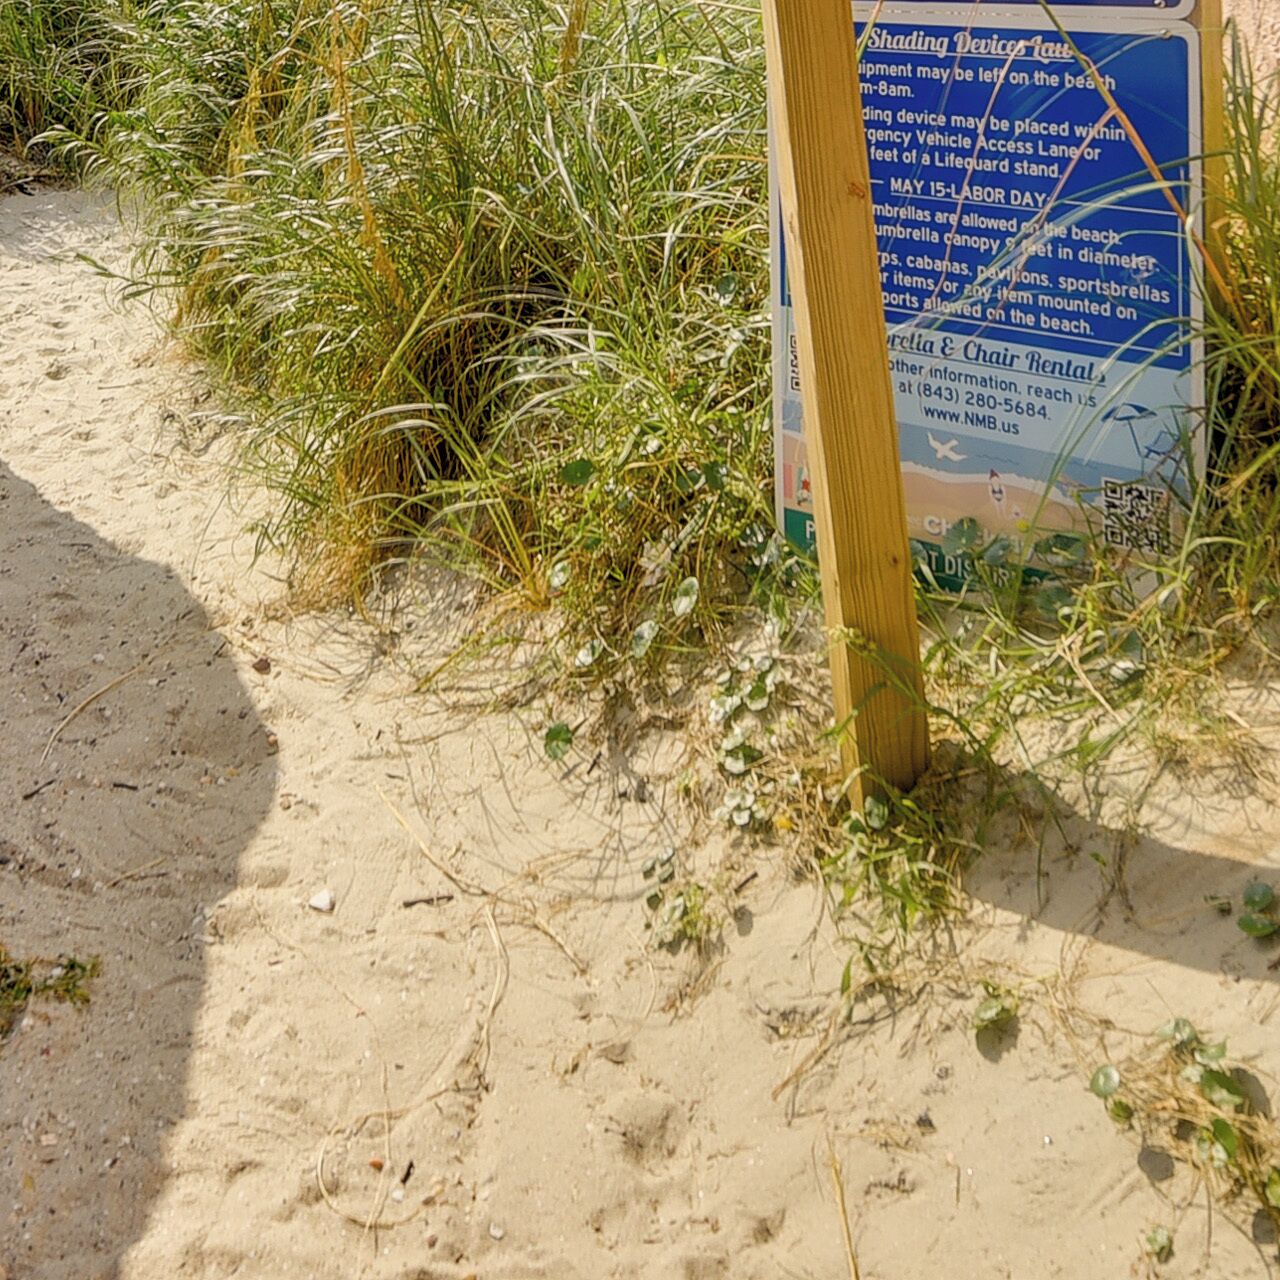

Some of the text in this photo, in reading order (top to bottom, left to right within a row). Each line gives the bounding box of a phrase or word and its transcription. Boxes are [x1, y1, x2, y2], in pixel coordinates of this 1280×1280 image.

[867, 27, 1073, 64] Shading Devices Law
[859, 81, 915, 98] m-8am.
[916, 66, 950, 84] may
[954, 67, 974, 81] be
[978, 67, 1004, 83] left
[1009, 71, 1029, 85] on
[1033, 70, 1060, 86] the
[1064, 72, 1116, 90] beah
[862, 106, 1126, 141] ding device may be placed within
[870, 145, 1062, 179] feet of a Lifeguard stand.
[915, 129, 972, 149] Vehicle
[978, 136, 1034, 155] Access
[1038, 140, 1078, 159] Lane
[1084, 148, 1101, 161] or
[890, 177, 925, 195] MAY
[929, 181, 1006, 204] 15-LABOR
[872, 203, 932, 222] mbrellas
[934, 211, 958, 225] are
[961, 212, 1018, 232] allowed
[1043, 222, 1068, 237] the
[874, 223, 940, 244] umbrella
[943, 232, 1000, 255] canopy
[1023, 240, 1053, 258] eet
[1058, 243, 1074, 261] in
[1078, 247, 1160, 273] diameter.
[942, 280, 959, 294] or
[964, 284, 992, 303] any
[997, 285, 1033, 305] item
[1038, 293, 1111, 317] mounted
[1116, 306, 1138, 321] on
[977, 265, 1053, 288] pavilons,
[1058, 276, 1170, 304] sportsbrellas
[923, 296, 982, 319] allowed
[986, 307, 1005, 322] on
[1009, 308, 1035, 327] the
[1040, 312, 1095, 336] beach.
[886, 332, 935, 354] rella
[940, 336, 956, 357] &
[963, 339, 1020, 369] Chair
[888, 358, 924, 376] other
[1026, 384, 1073, 403] reach
[899, 380, 1052, 421] at (843) 280-5684.
[923, 405, 1020, 435] www.NMB.us
